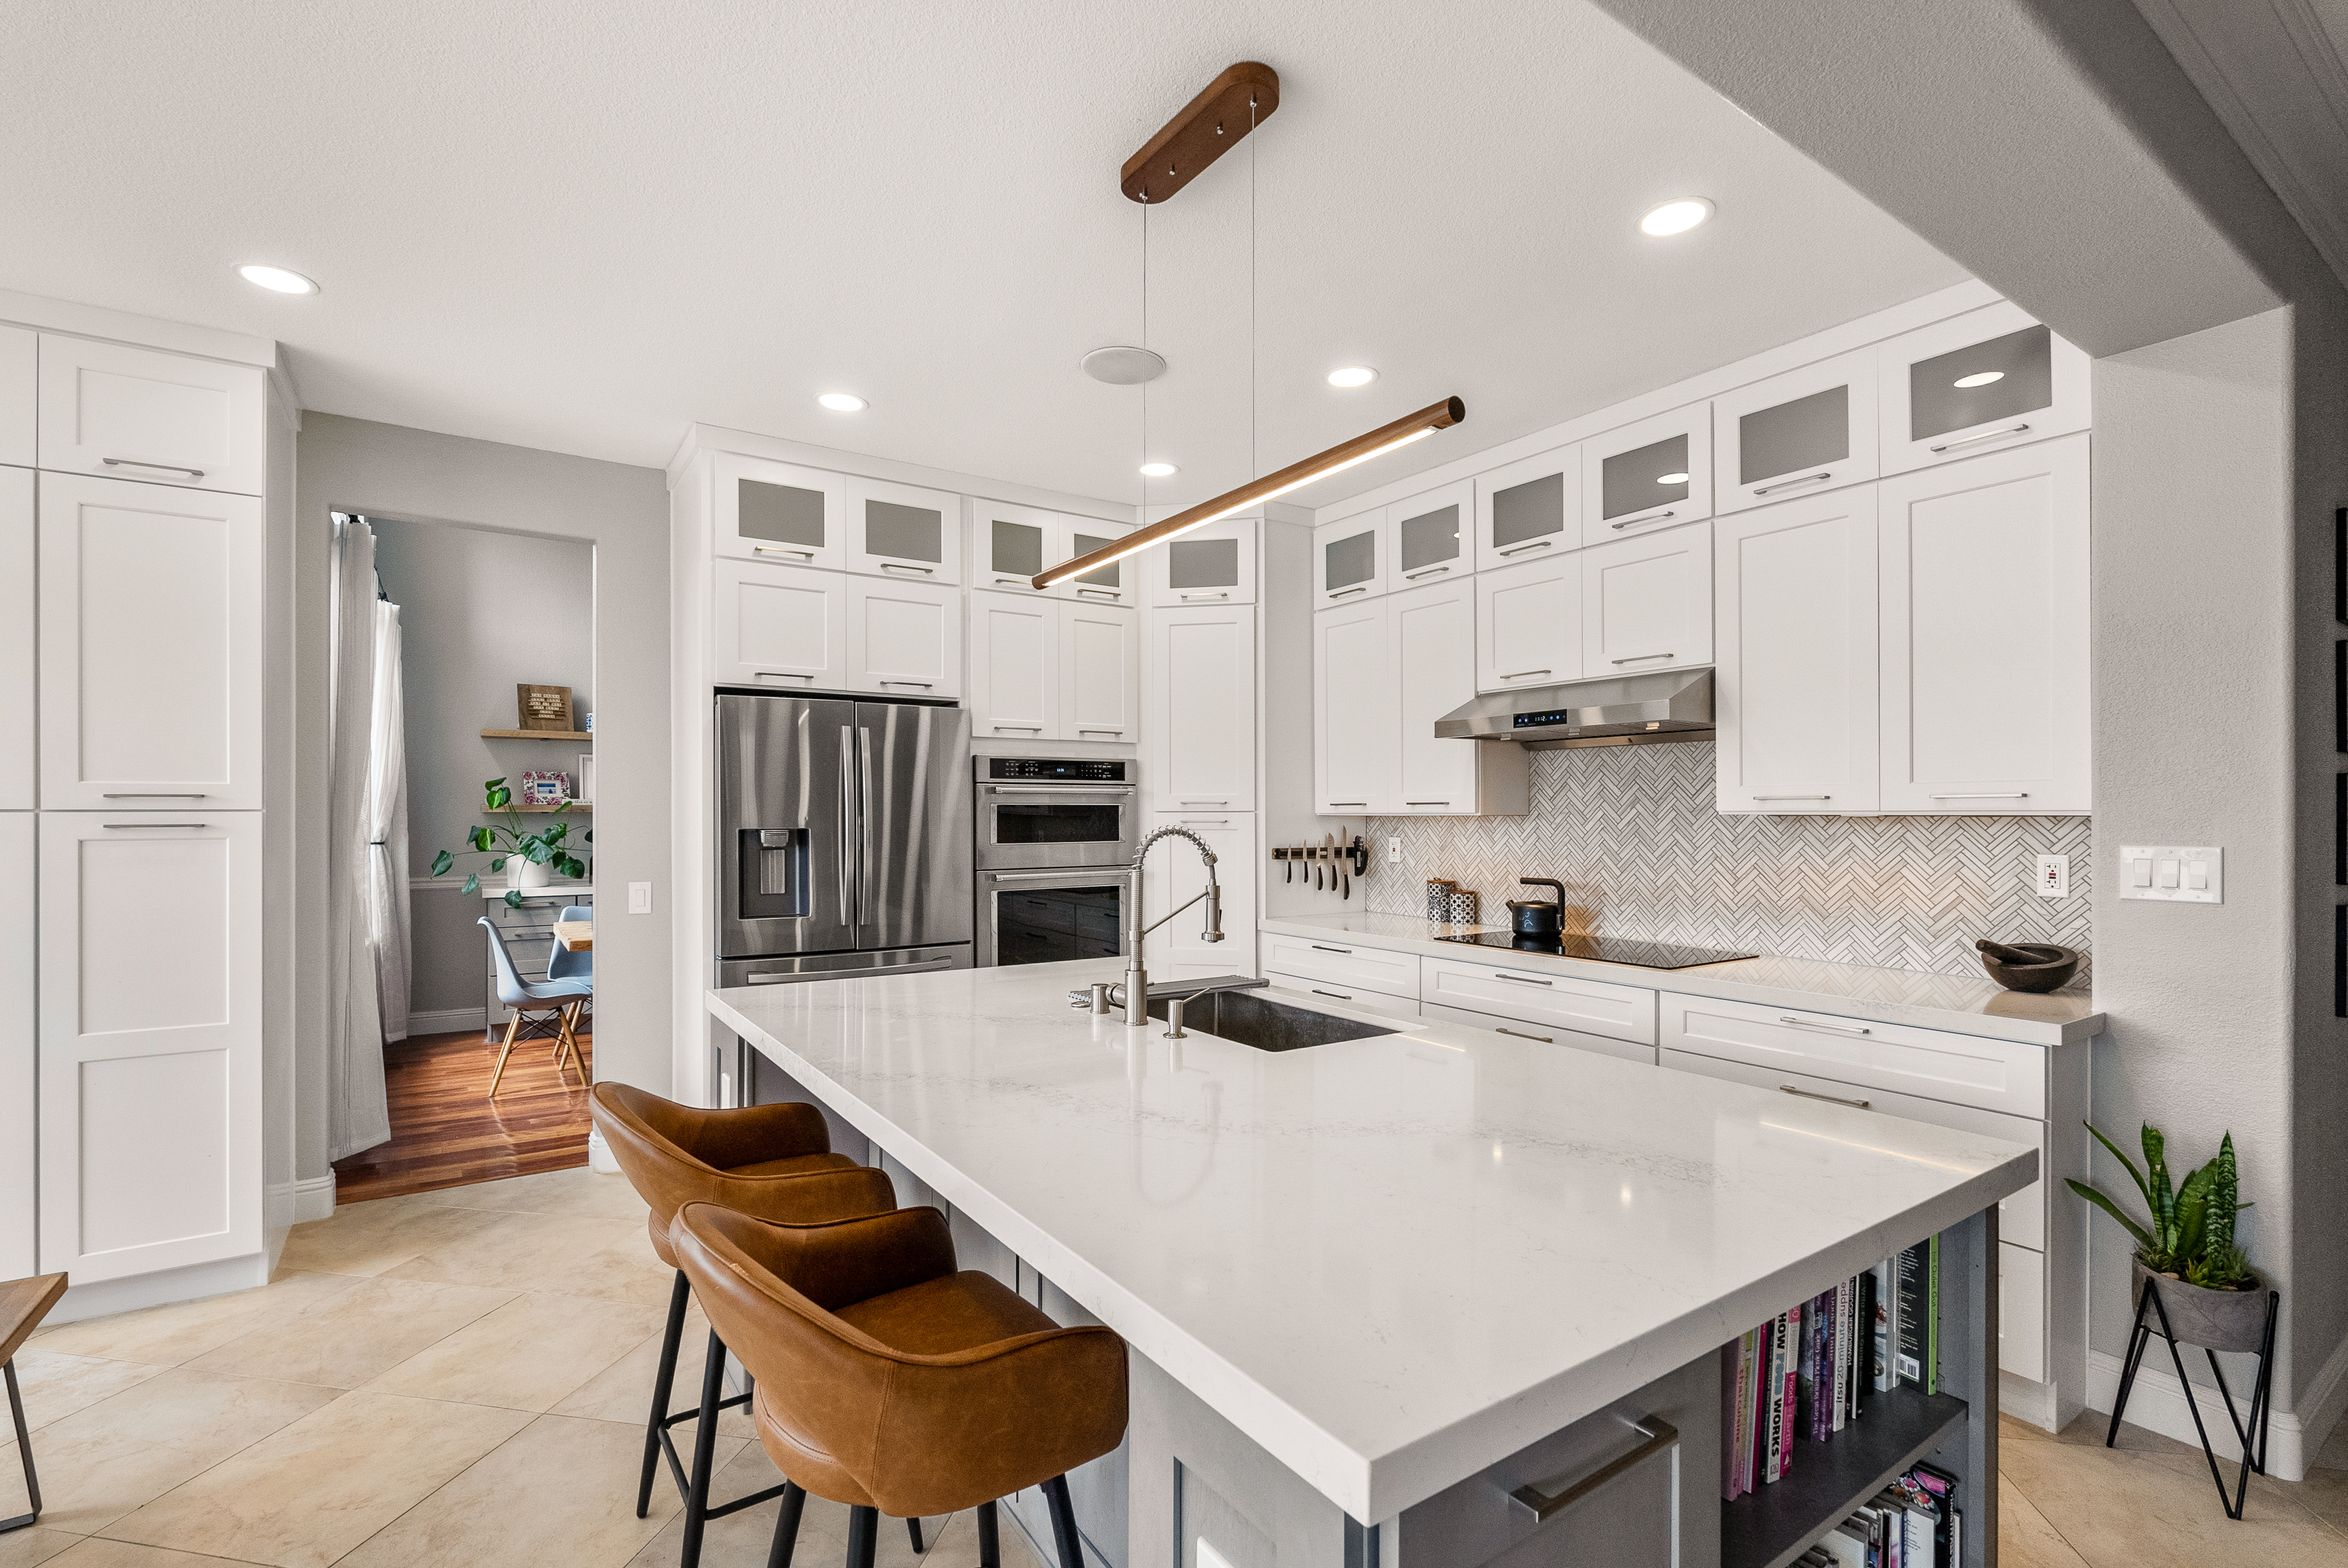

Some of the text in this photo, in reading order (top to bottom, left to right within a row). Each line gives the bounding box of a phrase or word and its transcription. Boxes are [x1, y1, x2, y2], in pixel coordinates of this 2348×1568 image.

[1777, 1312, 1787, 1350] HOW
[1837, 1321, 1845, 1379] 20-minute
[1771, 1397, 1782, 1457] WORKS
